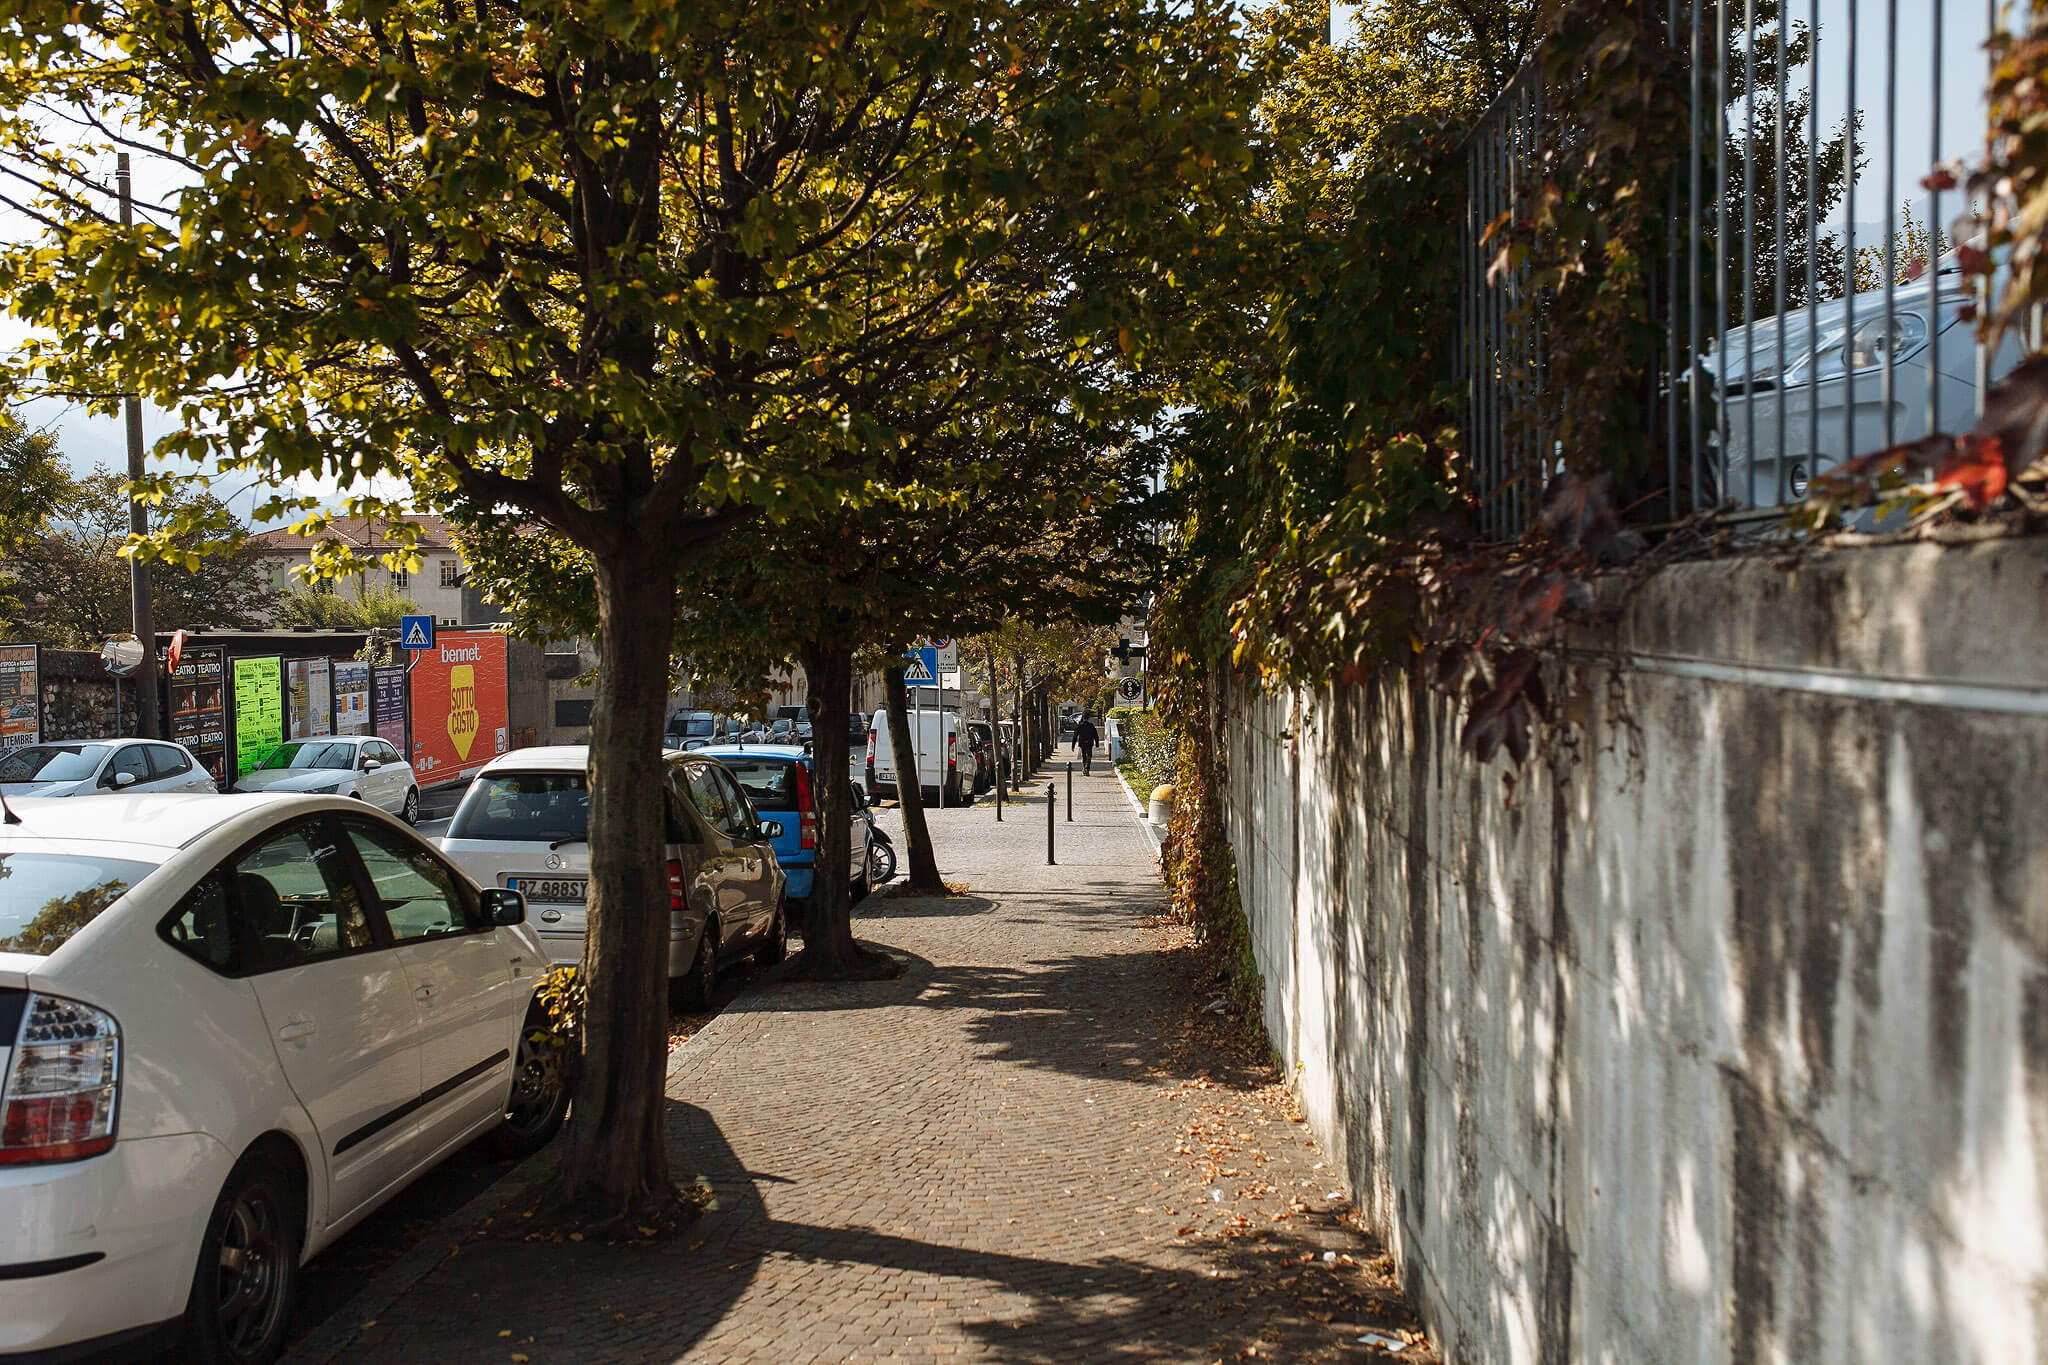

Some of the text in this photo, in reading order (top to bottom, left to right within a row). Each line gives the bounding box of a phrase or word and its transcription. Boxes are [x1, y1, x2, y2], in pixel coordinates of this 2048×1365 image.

[441, 642, 482, 663] bennet
[173, 664, 196, 676] EATRO
[197, 662, 221, 674] TEATRO
[451, 686, 474, 710] SOTTO
[452, 710, 475, 735] COSTO
[200, 731, 224, 744] TEATRO
